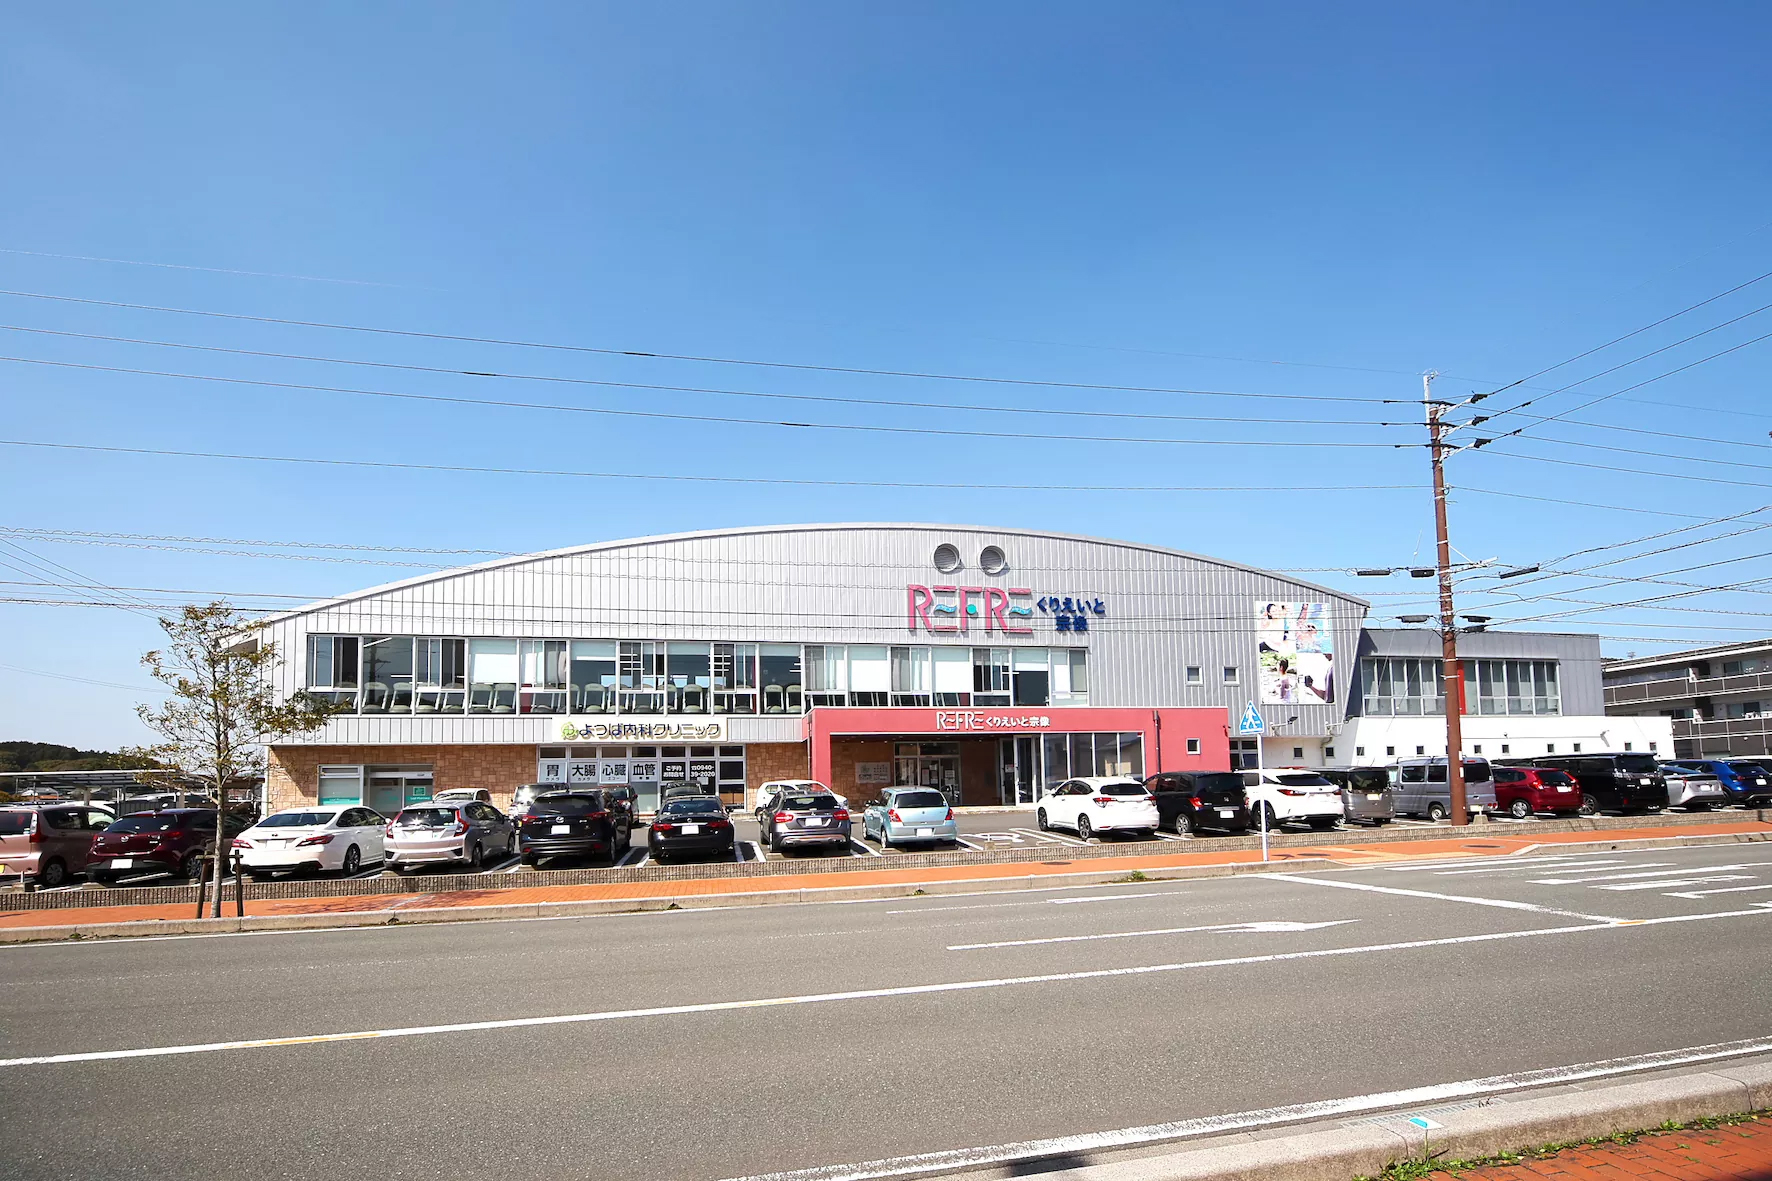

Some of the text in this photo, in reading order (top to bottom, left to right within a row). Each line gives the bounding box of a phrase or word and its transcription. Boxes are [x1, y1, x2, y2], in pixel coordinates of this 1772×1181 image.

[1037, 596, 1106, 614] くりえいと
[1056, 615, 1088, 632] 宗像
[986, 716, 1051, 727] くりえいと宗像
[579, 723, 721, 738] よつば内科クリニック
[546, 764, 560, 777] 胃
[571, 764, 596, 777] 大腸
[602, 764, 626, 777] 心臓
[632, 763, 656, 776] 血管
